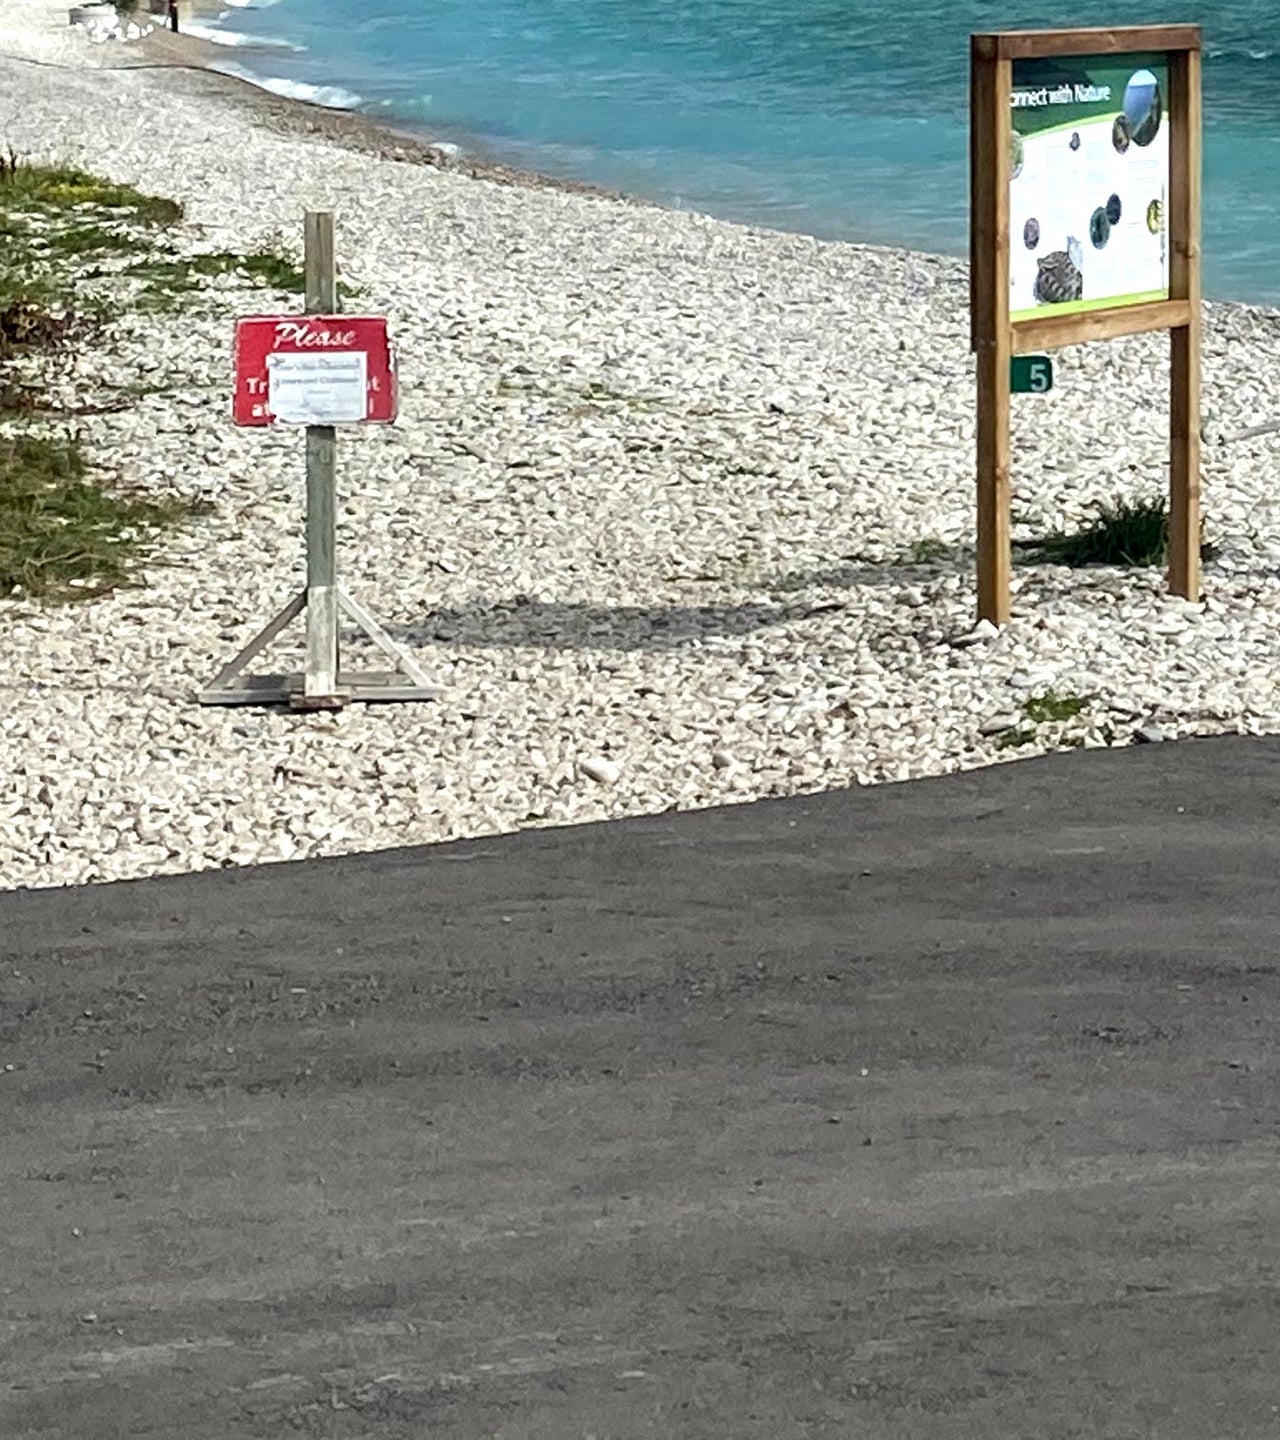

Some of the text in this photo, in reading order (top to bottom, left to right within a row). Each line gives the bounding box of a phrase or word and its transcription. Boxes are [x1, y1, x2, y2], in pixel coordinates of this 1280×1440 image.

[1048, 84, 1073, 104] with
[1074, 84, 1111, 102] Nature
[273, 322, 356, 348] Please
[1030, 363, 1048, 391] 5
